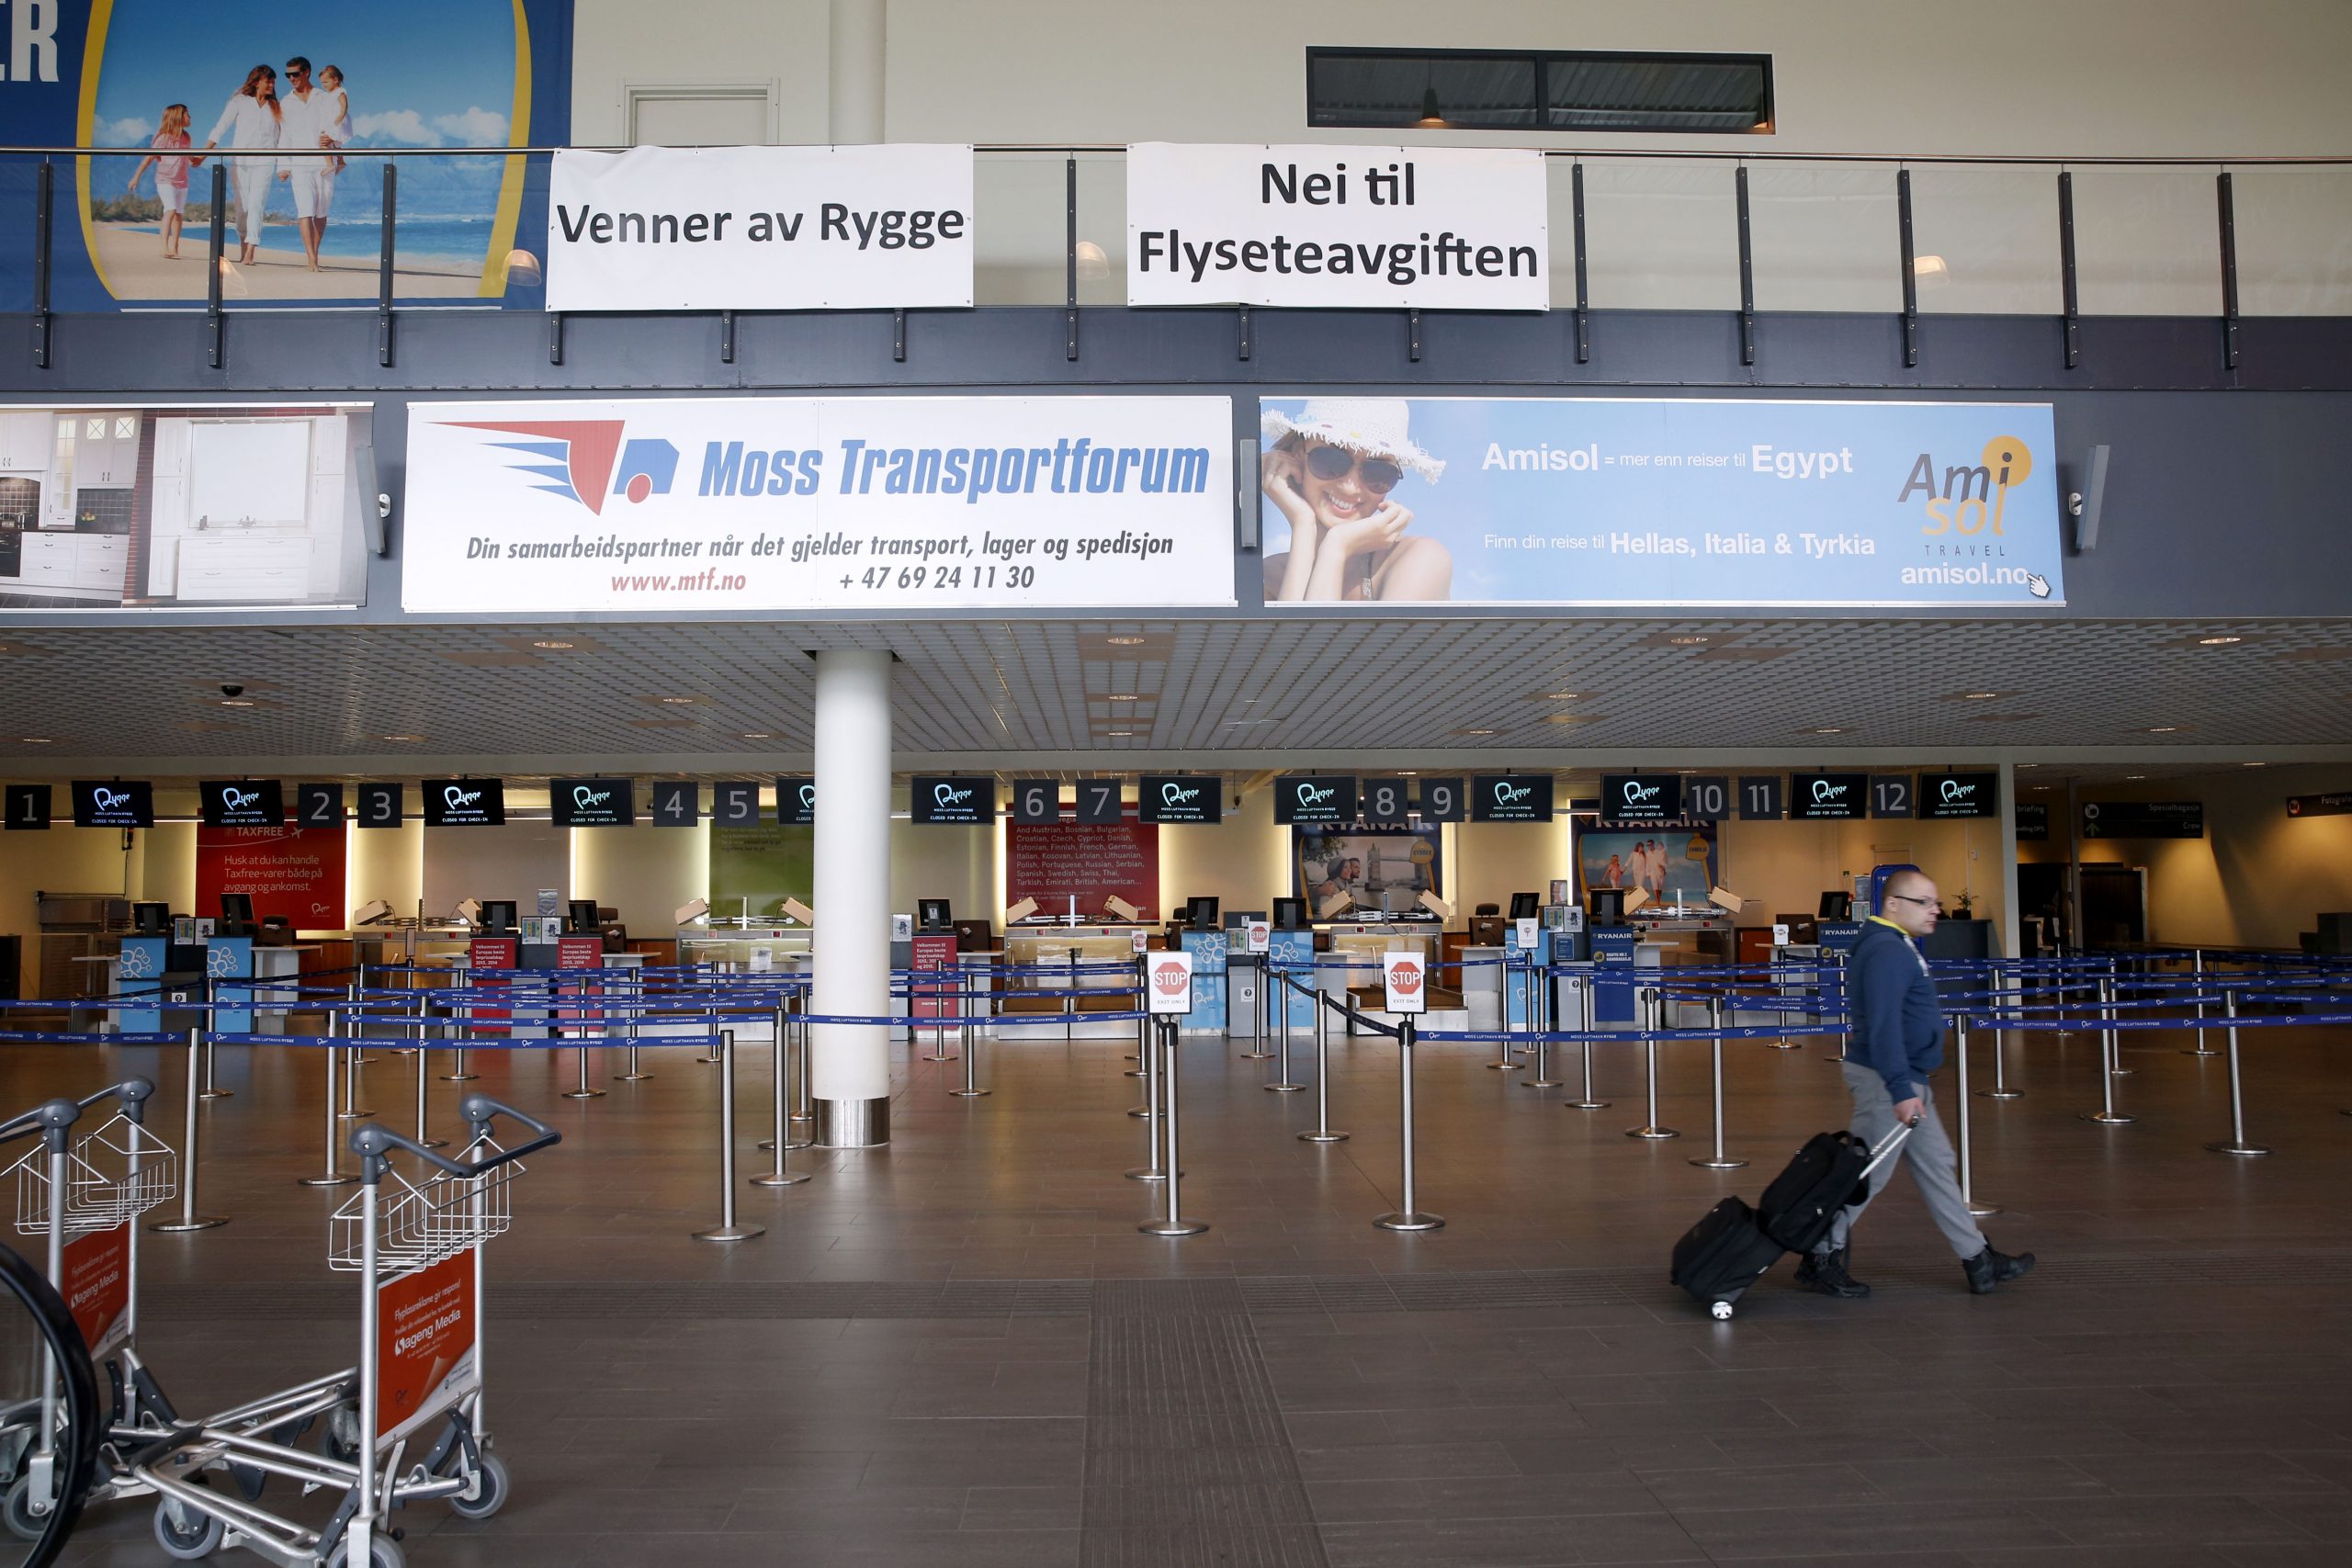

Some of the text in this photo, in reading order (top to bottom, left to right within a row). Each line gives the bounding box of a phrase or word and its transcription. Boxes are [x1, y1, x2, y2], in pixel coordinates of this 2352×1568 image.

[1262, 163, 1414, 205] Nei til
[557, 203, 964, 250] Venner av Rygge
[1140, 230, 1537, 285] Flyseteavgiften
[698, 438, 1209, 503] Moss Transportforum
[1482, 443, 1598, 470] Amisol
[1621, 456, 1649, 466] mer
[1655, 456, 1681, 466] enn
[1688, 453, 1729, 466] reiser
[1734, 453, 1745, 466] til
[1752, 446, 1852, 479] Egypt
[467, 531, 1172, 564] Din samarbeidspartner når det gjelder transport, lager og spedisjon
[1486, 533, 1874, 558] Finn din reise til Hellas, Italia & Tyrkia
[1926, 546, 2004, 556] TRAVEL
[612, 567, 746, 591] www.mtf.no
[862, 567, 891, 588] 47
[899, 567, 926, 589] 69
[934, 567, 961, 588] 24
[974, 567, 995, 588] 11
[1006, 566, 1034, 588] 30
[1901, 562, 2028, 585] amisol.no
[22, 794, 37, 821] 1
[311, 792, 329, 820] 2
[373, 792, 391, 820] 3
[665, 790, 684, 818] 4
[729, 790, 748, 818] 5
[1025, 788, 1044, 817] 6
[1091, 787, 1110, 816] 7
[1375, 787, 1395, 816] 8
[1432, 786, 1452, 815] 9
[1691, 784, 1723, 813] 10
[1747, 784, 1770, 813] 11
[1875, 783, 1906, 811] 12
[236, 826, 284, 837] TAXFREE
[1077, 835, 1106, 844] Cypriot,
[1097, 826, 1131, 834] Bulgarian,
[225, 854, 320, 865] Husk at du kan handle
[1041, 862, 1083, 870] Portuguese,
[225, 867, 323, 880] Taxfree-varer både på
[1016, 870, 1044, 878] Spanish,
[223, 882, 311, 894] avgang og ankomst.
[1155, 972, 1187, 987] STOP
[1391, 971, 1420, 986] STOP
[435, 1309, 461, 1332] Media
